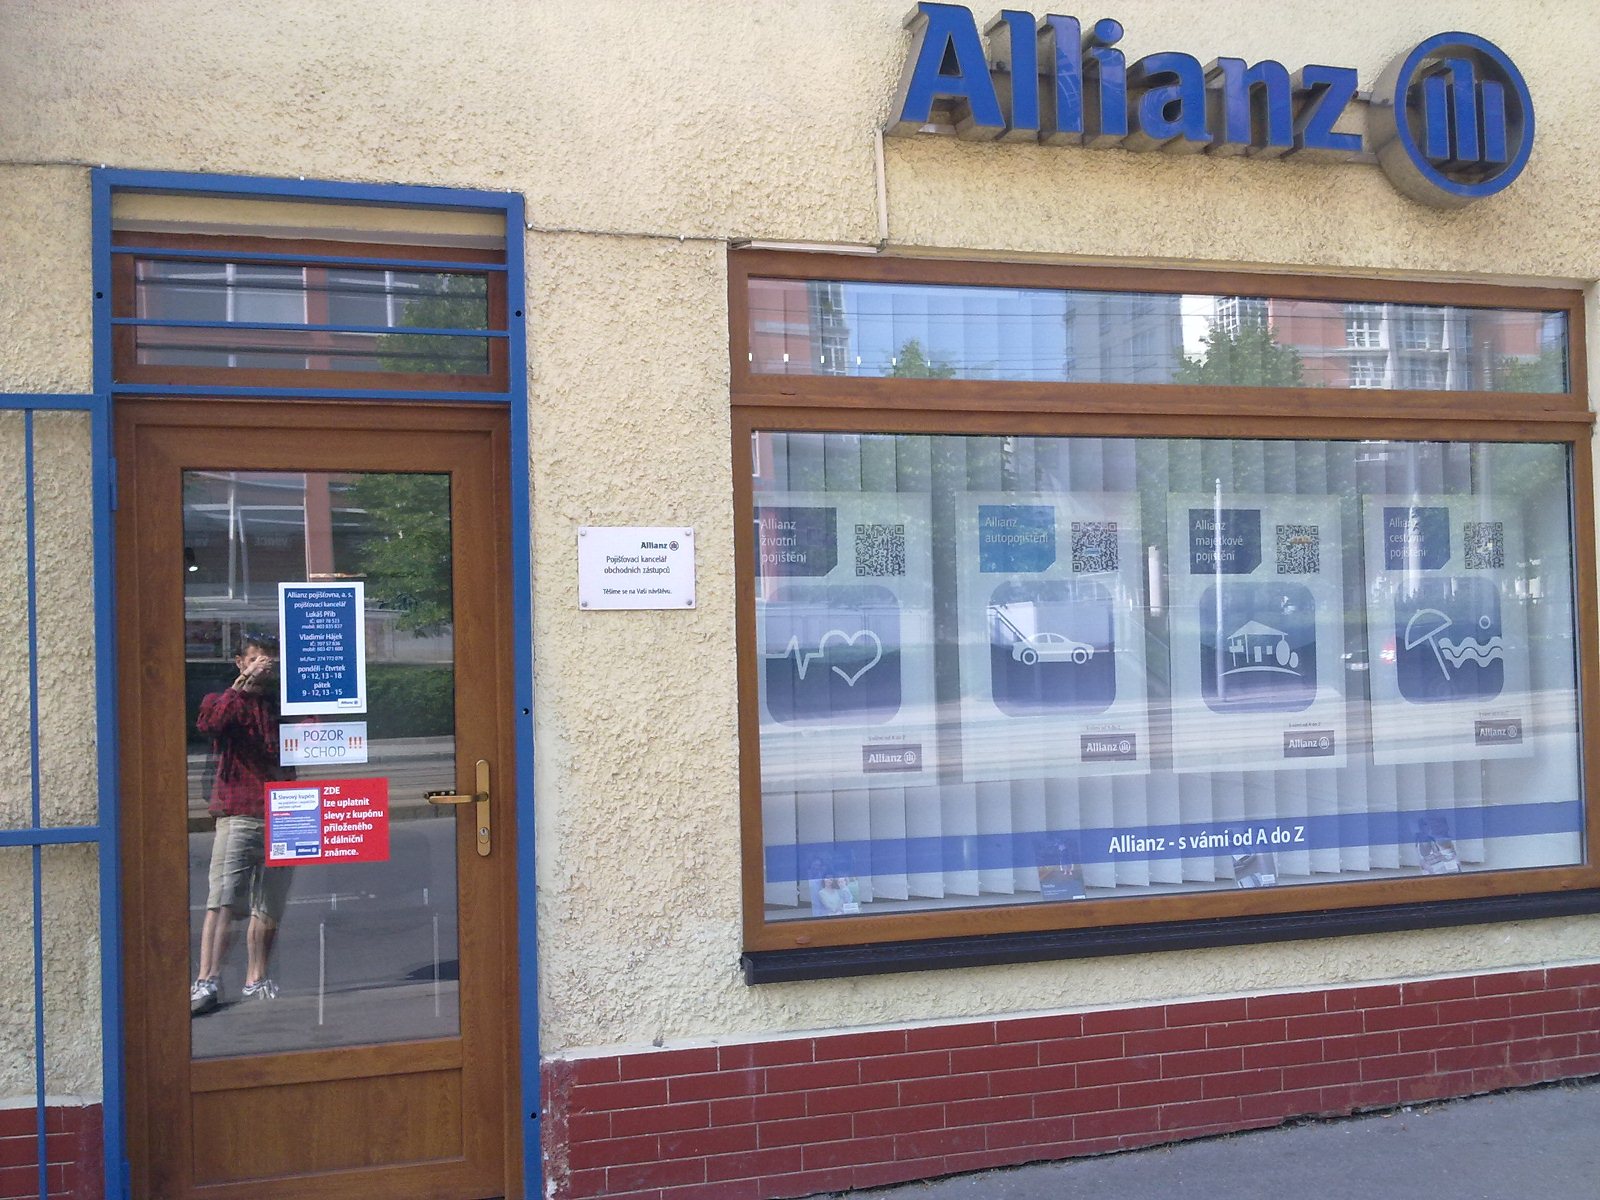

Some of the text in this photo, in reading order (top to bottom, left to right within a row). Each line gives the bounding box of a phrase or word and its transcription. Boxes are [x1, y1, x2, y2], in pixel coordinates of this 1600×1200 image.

[898, 2, 1363, 152] Allianz
[760, 519, 796, 529] Allianz
[985, 517, 1018, 527] Allianz
[1196, 520, 1225, 530] Allianz
[761, 535, 796, 546] životní
[606, 556, 639, 564] Pojišťovací
[762, 552, 807, 565] pojištění
[643, 566, 670, 575] zástupců
[304, 730, 344, 742] POZOR
[1087, 742, 1118, 752] Allianz
[1289, 739, 1318, 748] Allianz
[304, 746, 346, 758] SCHOD
[869, 753, 902, 763] Allianz
[324, 799, 336, 807] lze
[337, 798, 369, 808] uplatnit
[324, 811, 344, 820] slevy
[352, 810, 383, 820] kupónu
[324, 823, 373, 834] přiloženého
[324, 835, 363, 844] k dálniční
[1108, 834, 1165, 853] Allianz
[1178, 836, 1186, 850] s
[1190, 830, 1229, 849] vámi
[1232, 828, 1252, 846] od
[1256, 829, 1268, 845] A
[1270, 826, 1290, 844] do
[1293, 826, 1305, 842] Z
[324, 848, 359, 856] známce.
